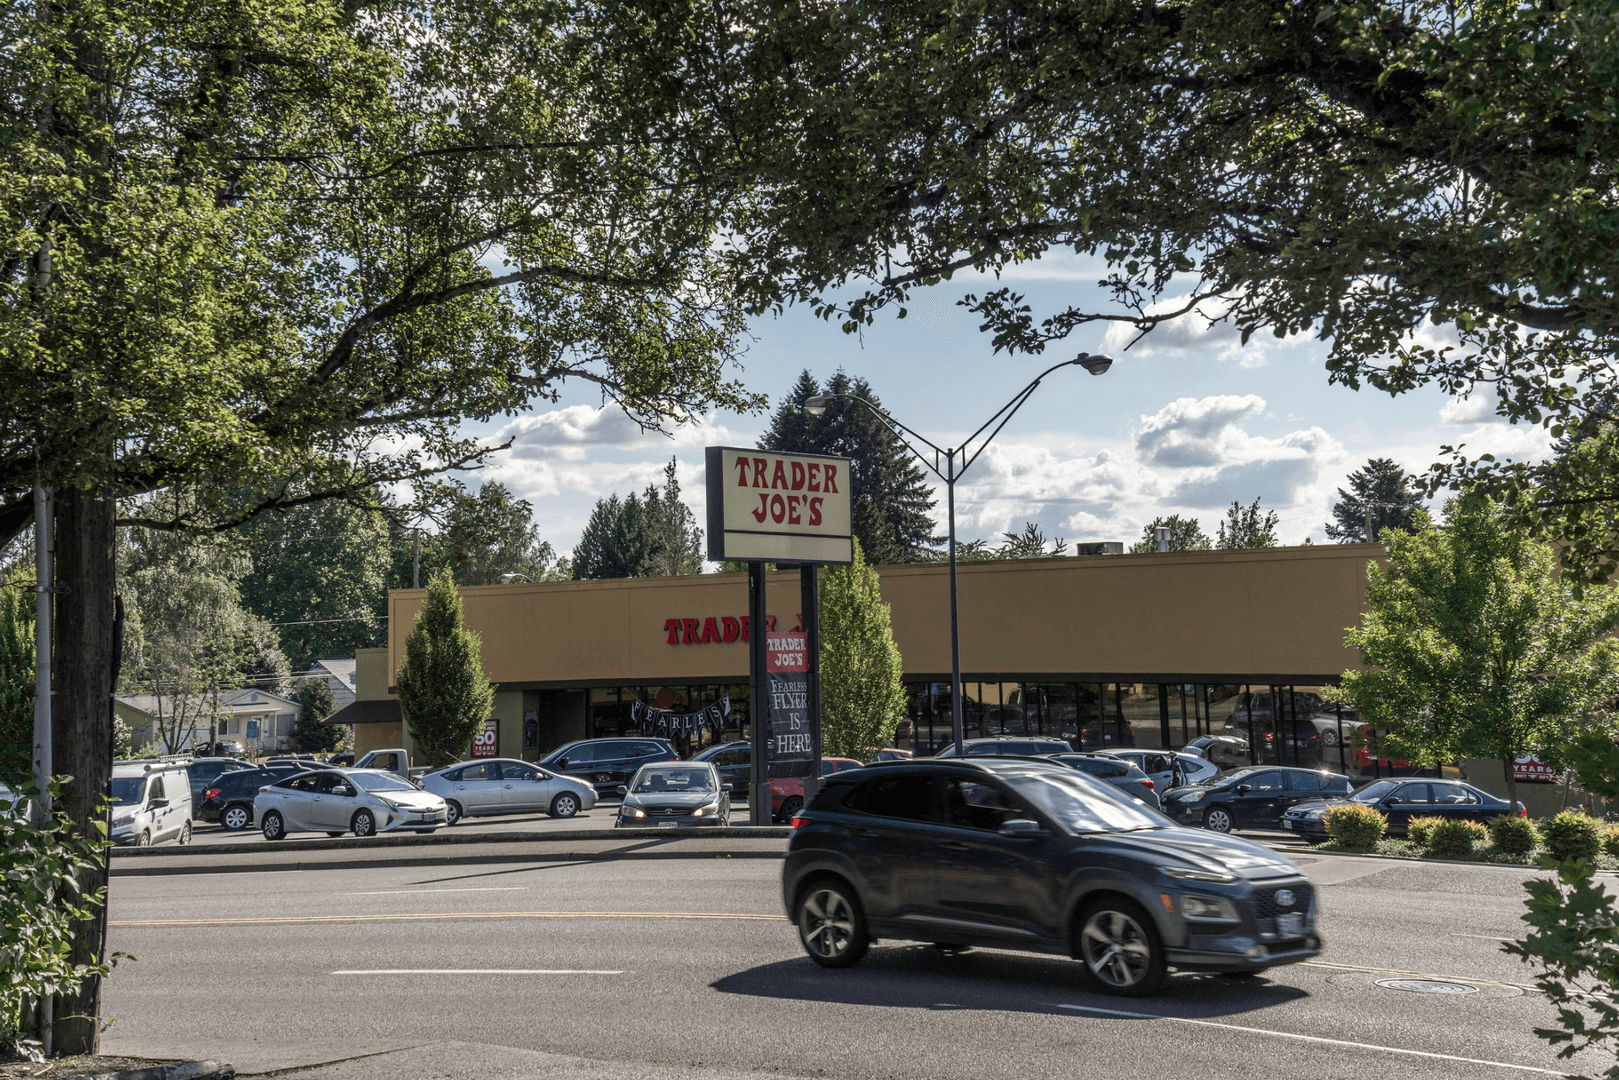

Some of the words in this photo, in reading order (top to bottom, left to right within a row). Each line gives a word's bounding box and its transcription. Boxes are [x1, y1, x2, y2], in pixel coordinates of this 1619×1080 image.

[734, 457, 839, 493] TRADER
[751, 493, 824, 526] JOE'S
[767, 638, 806, 651] TRADER
[774, 653, 803, 666] JOE'S
[770, 680, 808, 693] FEARLESS
[772, 692, 808, 710] FLYER
[789, 712, 801, 731] IS
[776, 733, 812, 754] HERE
